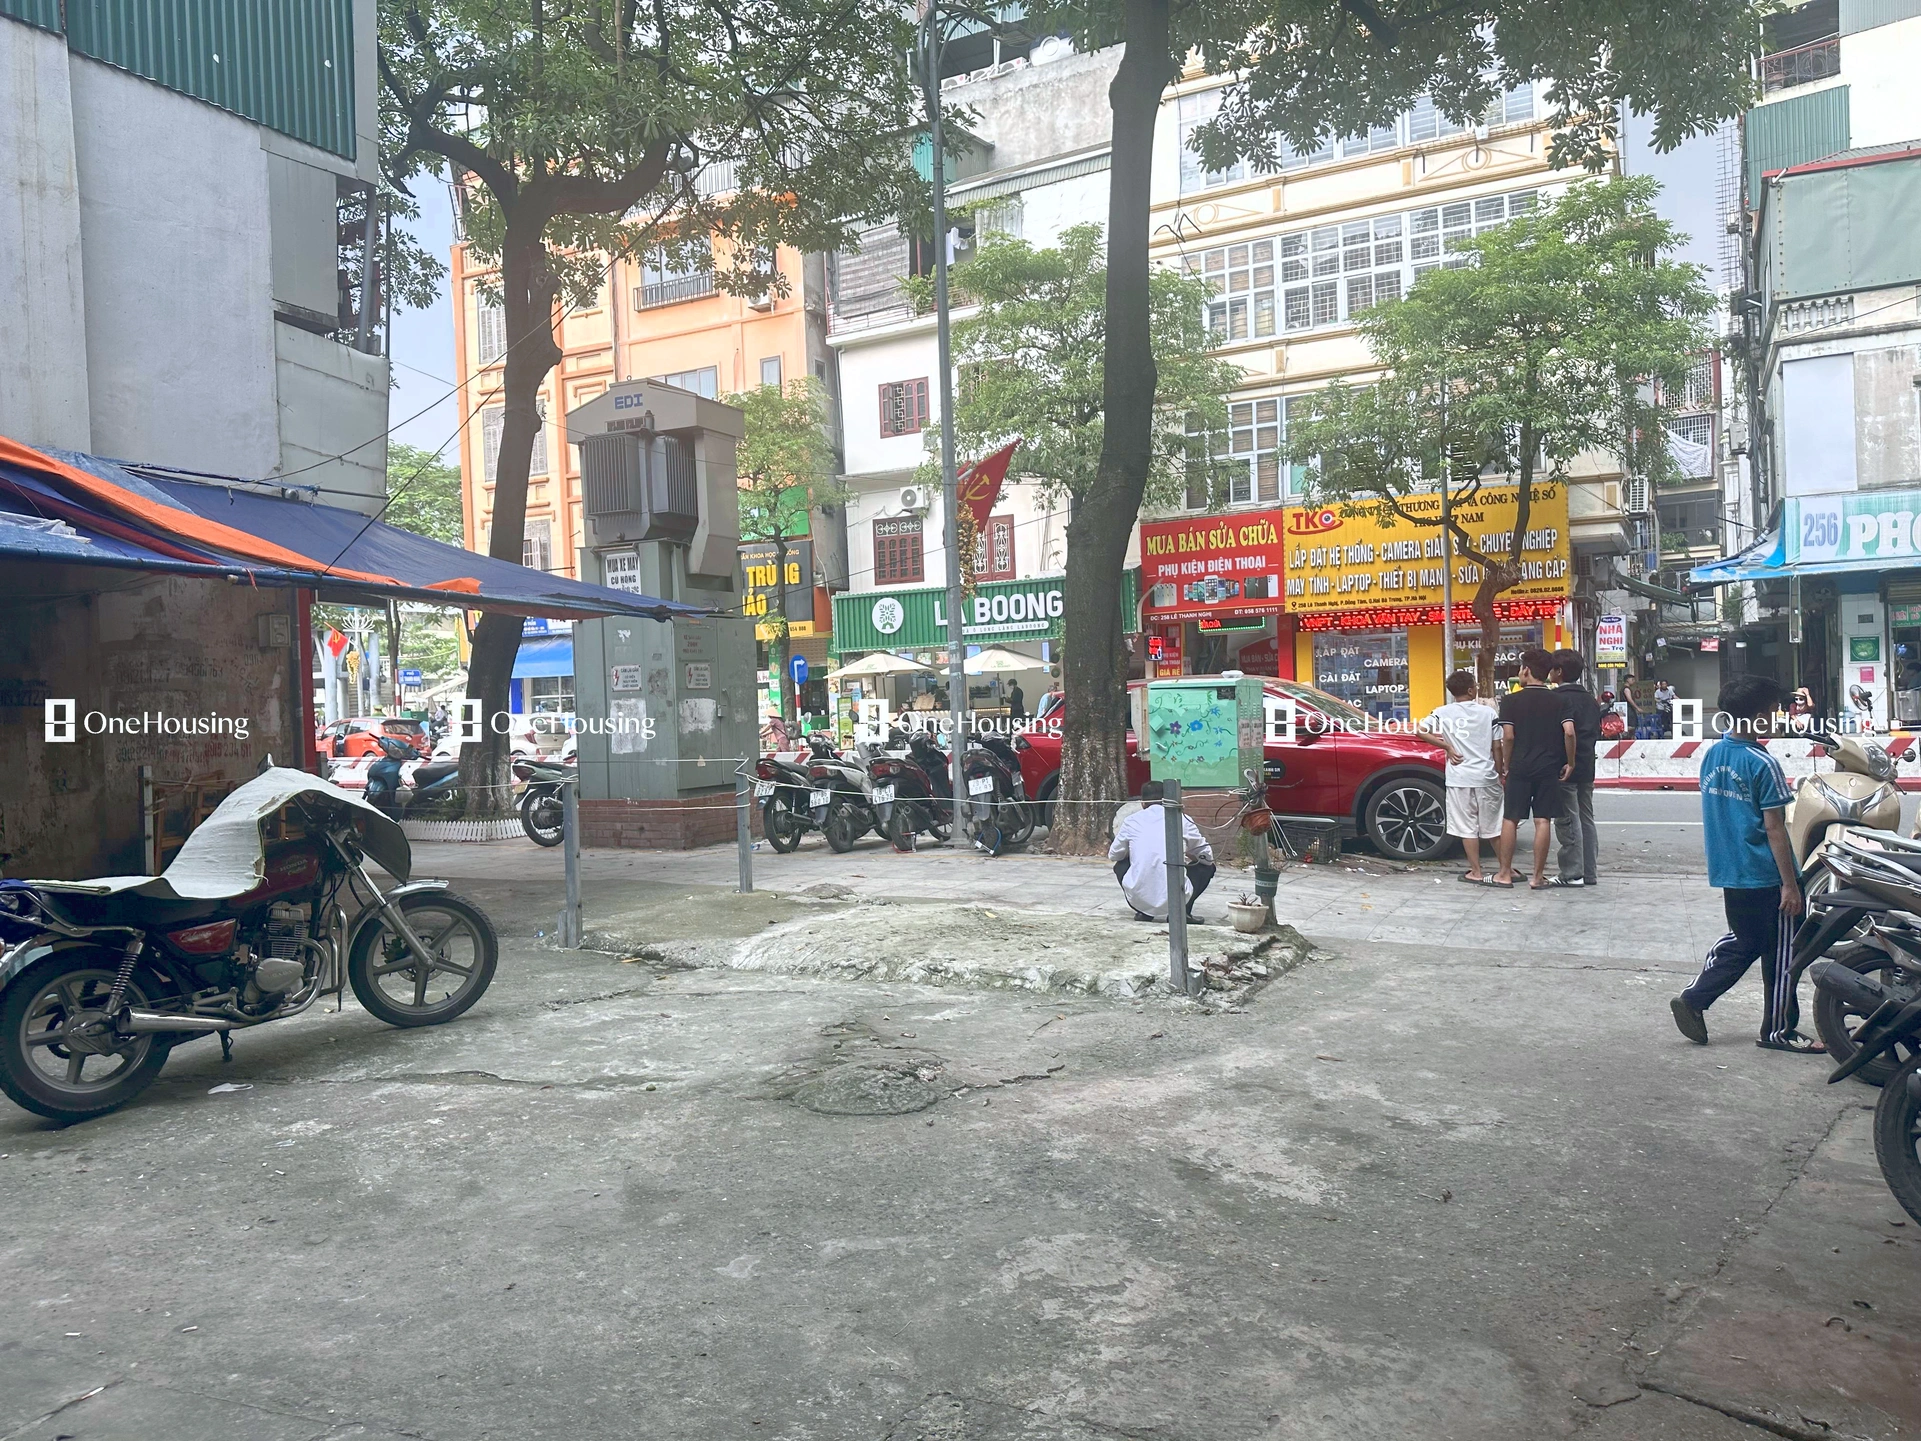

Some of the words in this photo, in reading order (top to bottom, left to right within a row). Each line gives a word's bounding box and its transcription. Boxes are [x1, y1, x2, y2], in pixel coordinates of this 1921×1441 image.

[615, 393, 643, 410] EDI
[1480, 491, 1508, 506] CÔNG
[1461, 511, 1485, 524] NAM
[1146, 534, 1175, 556] MUA
[1178, 527, 1206, 552] BÁN
[1208, 521, 1236, 550] SỬA
[1239, 519, 1279, 546] CHỮA
[1803, 512, 1839, 548] 256
[1289, 544, 1307, 569] LẮP
[1310, 545, 1327, 570] ĐẶT
[1329, 545, 1341, 568] HỆ
[1343, 539, 1374, 565] THỐNG
[1381, 539, 1421, 561] CAMERA
[1480, 528, 1514, 553] CHUYÊ
[619, 557, 626, 571] XE
[1158, 563, 1179, 579] PHỤ
[1181, 559, 1205, 577] KIỆN
[1207, 556, 1232, 574] ĐIỆN
[1234, 554, 1267, 571] THOẠI
[1287, 576, 1305, 595] MÁY
[1309, 573, 1329, 594] TÍNH
[1336, 573, 1371, 593] LAPTOP
[1378, 564, 1404, 589] THIẾT
[1407, 570, 1417, 590] BỊ
[1420, 568, 1443, 589] MẠN
[1545, 554, 1567, 578] CẤP
[974, 590, 1064, 623] BOONG
[1303, 617, 1334, 628] VNPT
[1396, 610, 1421, 622] TAY
[1599, 622, 1623, 635] NHÀ
[1363, 658, 1409, 668] CAMERA
[1341, 671, 1361, 684] ĐẶT
[1365, 684, 1405, 694] LAPTOP
